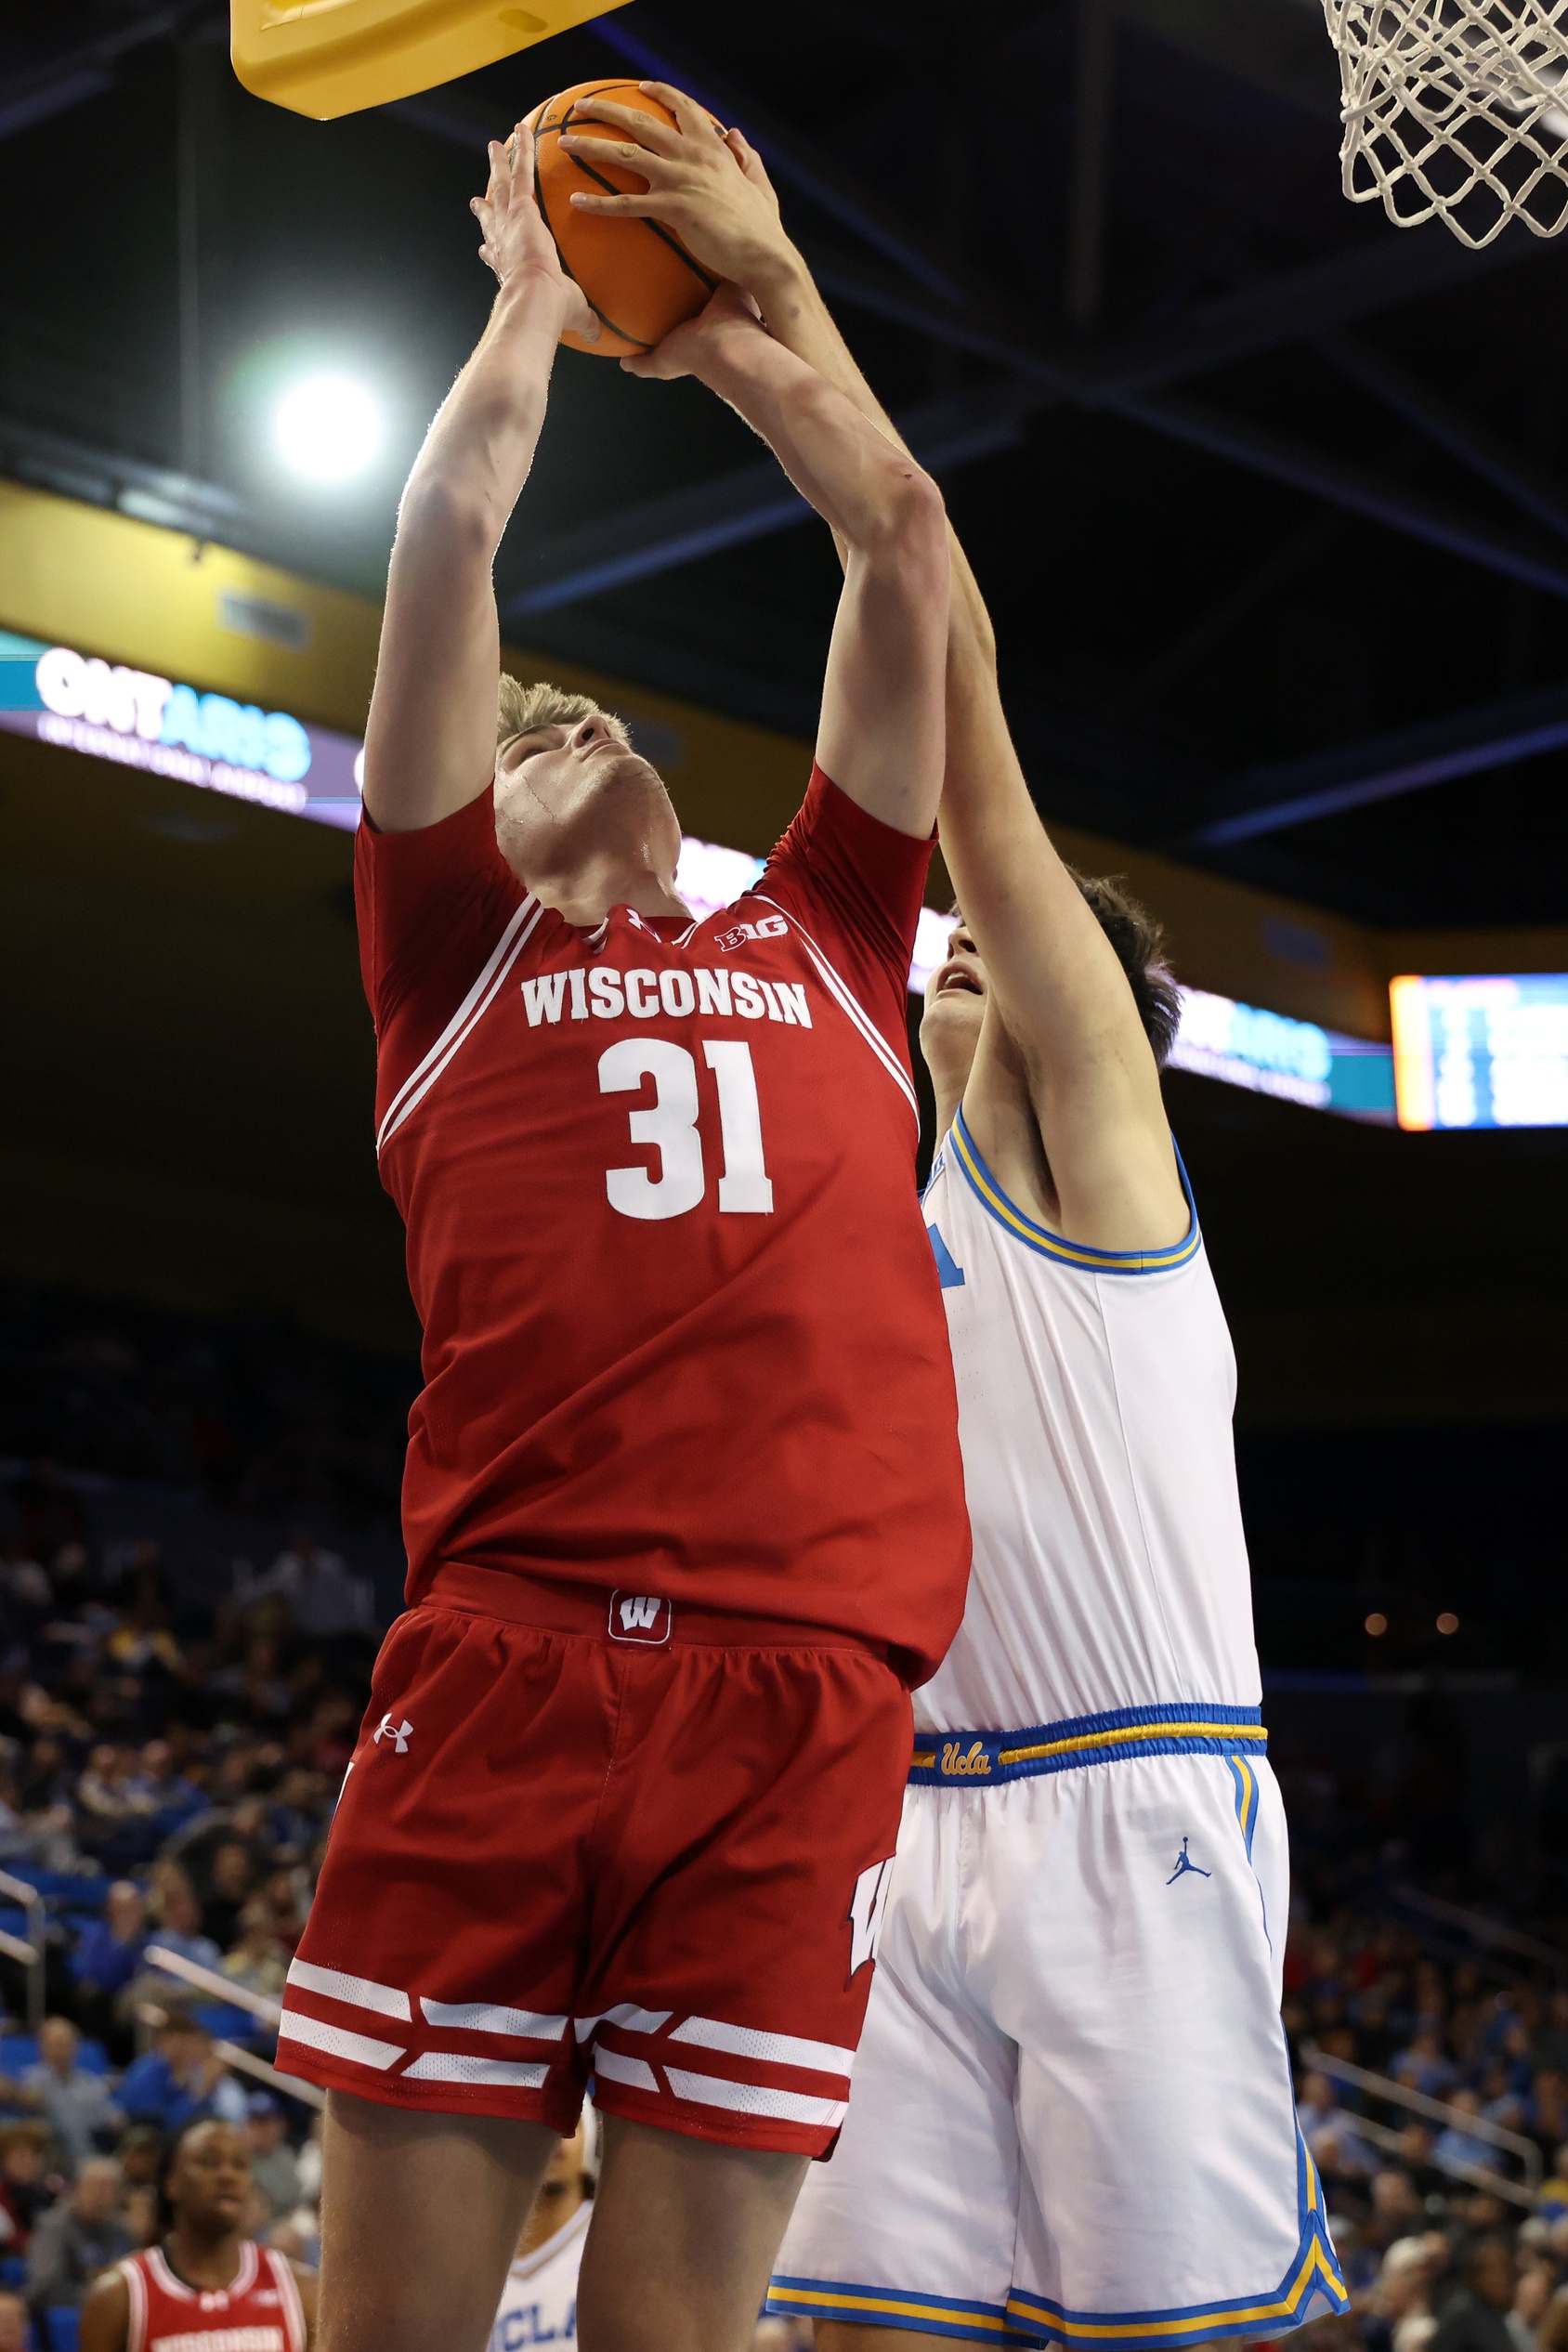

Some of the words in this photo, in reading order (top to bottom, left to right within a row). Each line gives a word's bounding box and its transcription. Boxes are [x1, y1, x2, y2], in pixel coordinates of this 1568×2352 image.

[520, 967, 814, 1029] WISCONSIN
[597, 1038, 774, 1221] 31
[619, 1596, 661, 1632] W
